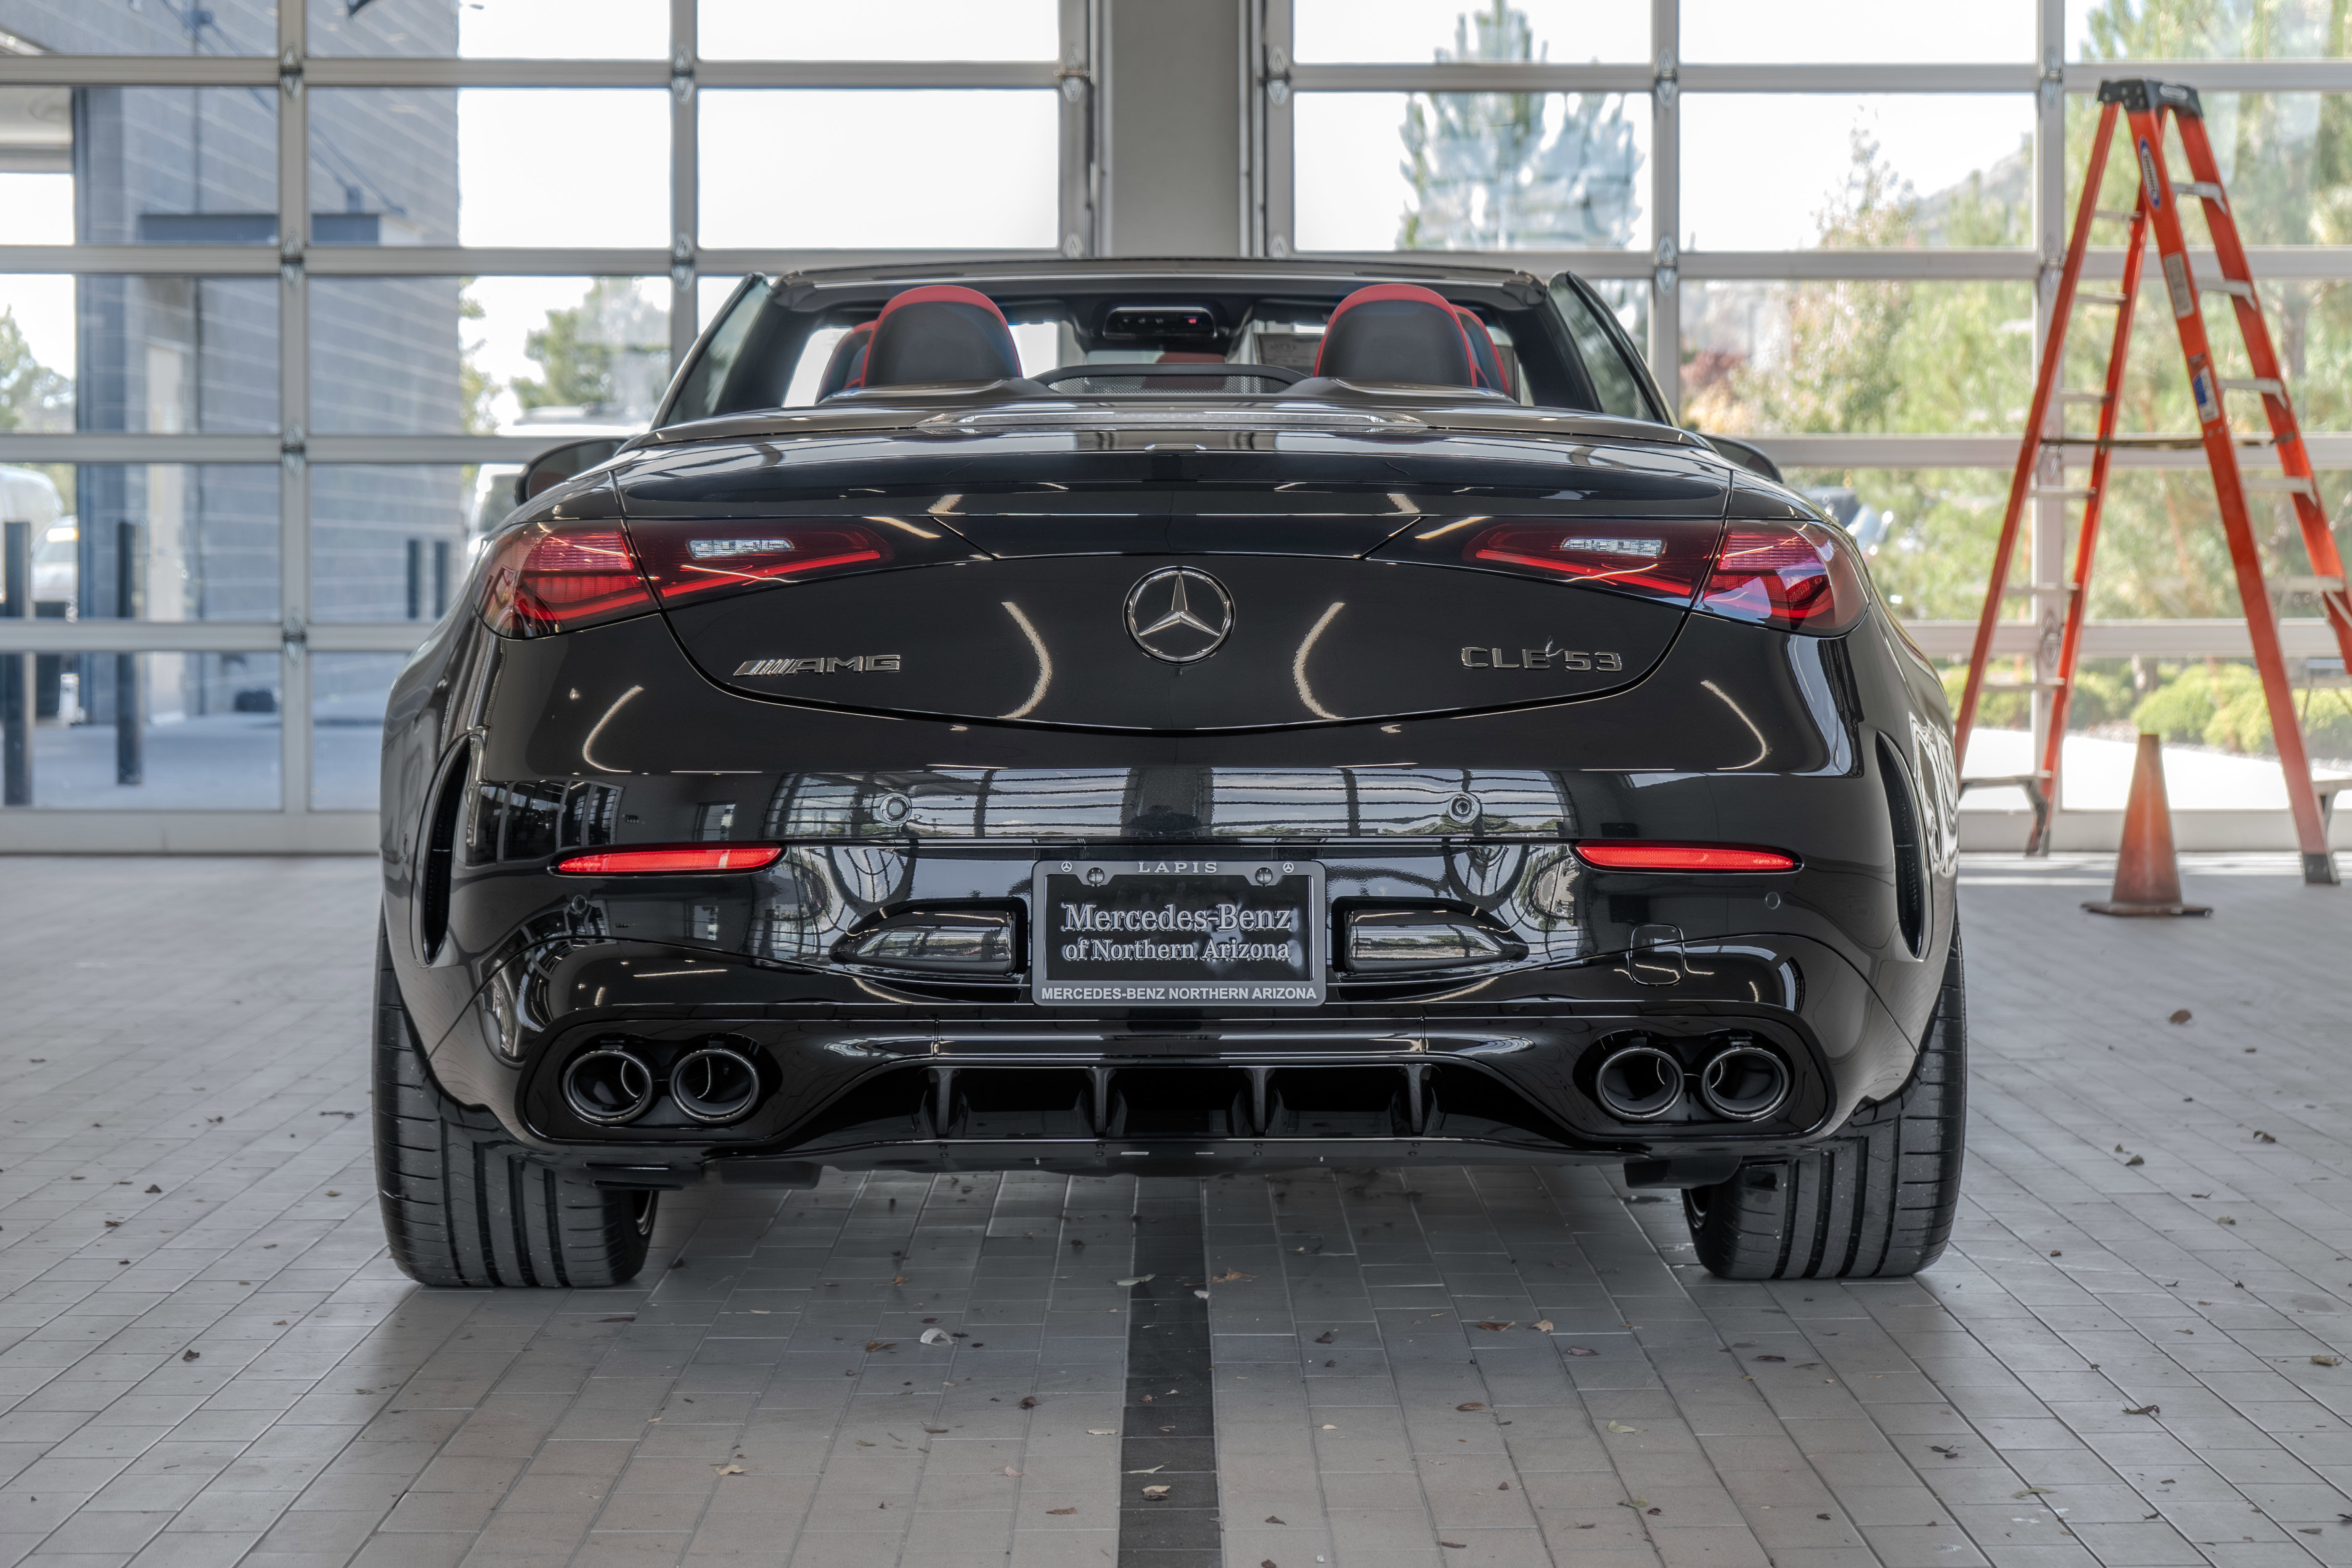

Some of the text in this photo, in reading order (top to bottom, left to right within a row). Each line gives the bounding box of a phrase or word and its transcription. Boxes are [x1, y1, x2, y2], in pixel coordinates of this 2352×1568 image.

[787, 654, 901, 673] AMG
[1461, 647, 1622, 672] CLE 53
[1138, 862, 1218, 874] LAPIS
[1064, 903, 1291, 931] Mercedes-Benz
[1065, 938, 1290, 961] of Northern Arizona
[1041, 988, 1317, 1000] MERCEDES-BENZ NORTHERN ARIZONA
